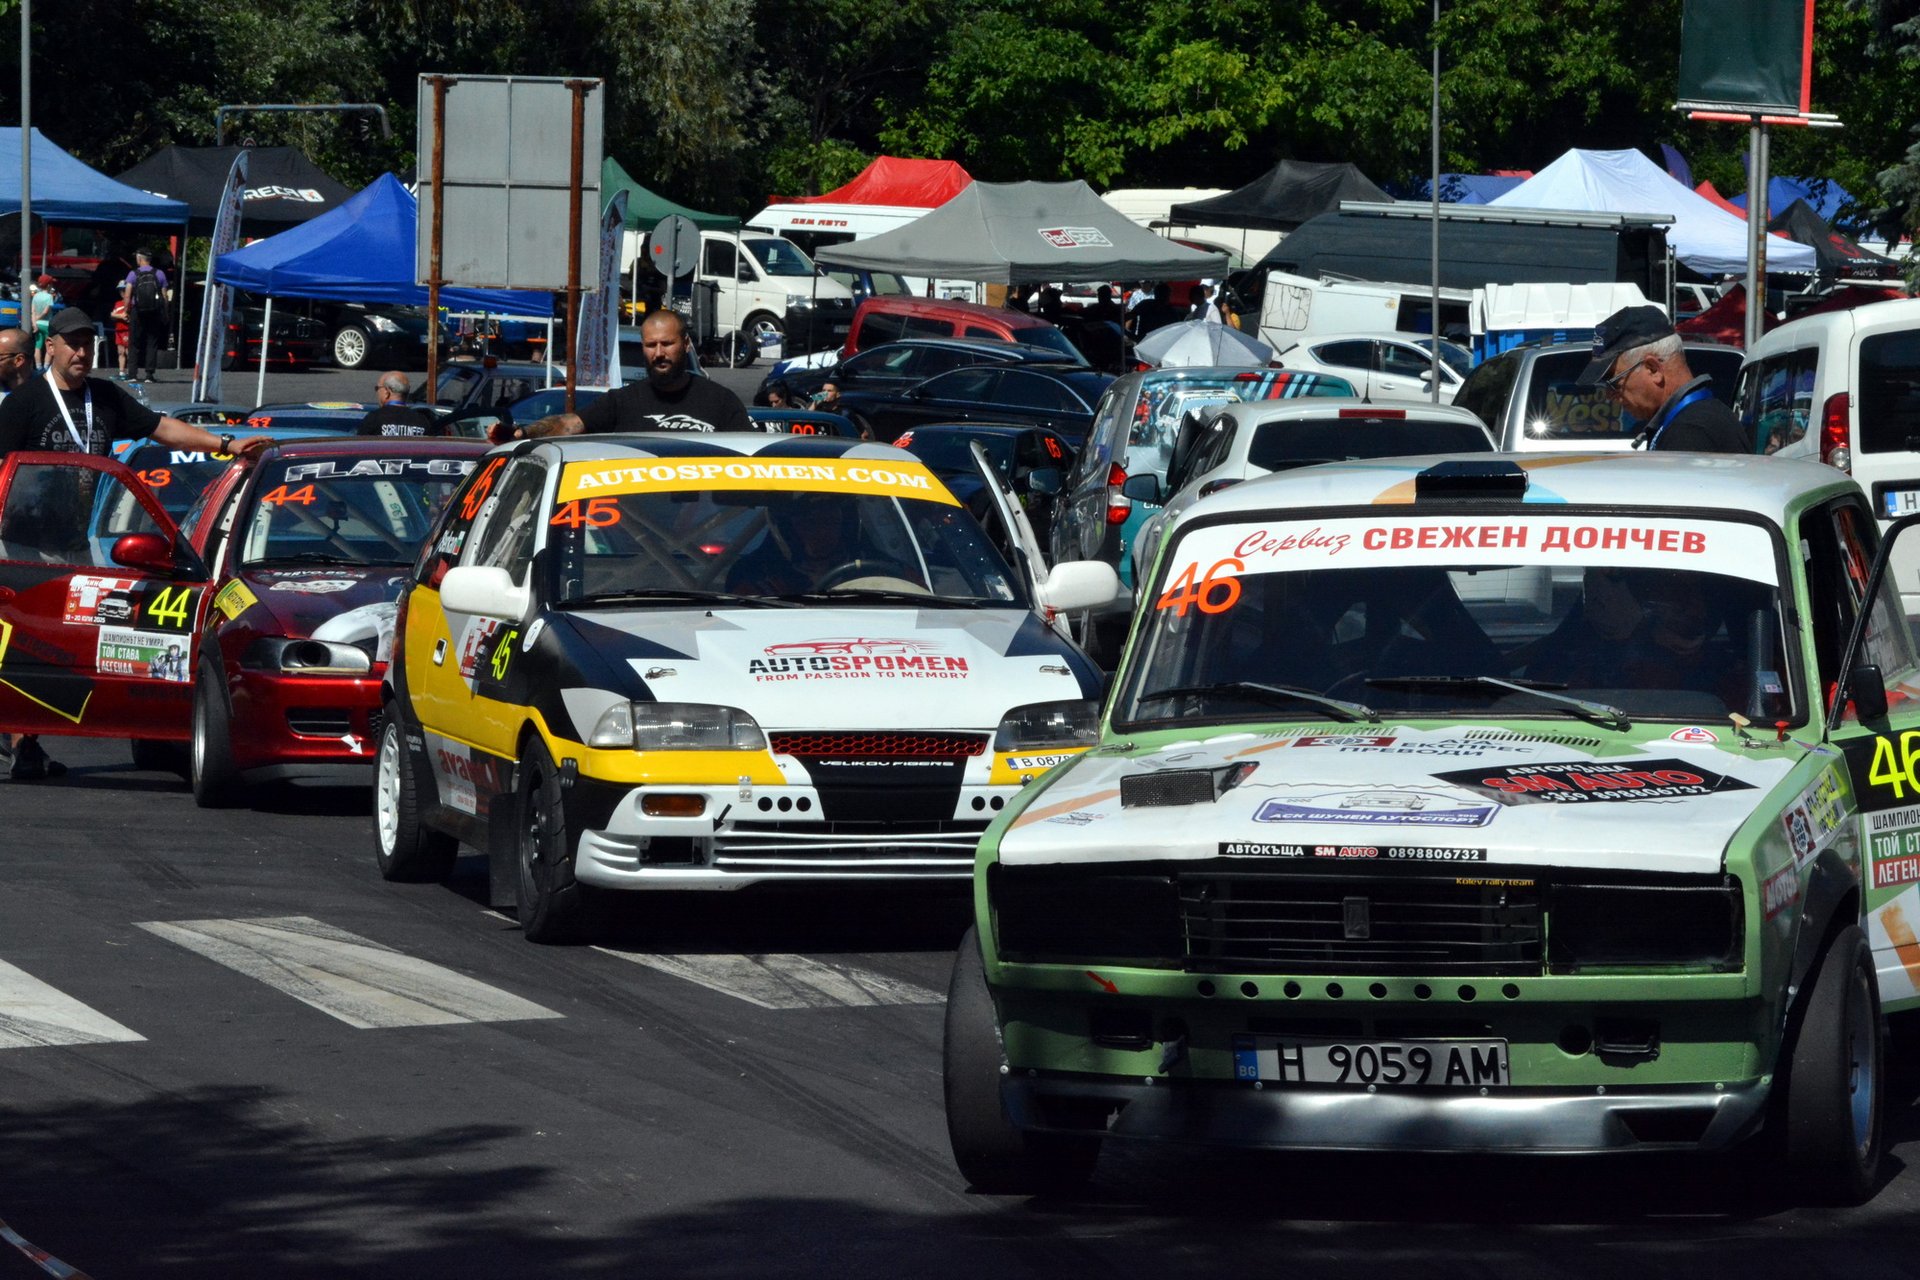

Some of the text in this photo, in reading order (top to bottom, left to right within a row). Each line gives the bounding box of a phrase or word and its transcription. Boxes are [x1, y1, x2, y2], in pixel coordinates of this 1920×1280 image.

[576, 463, 933, 491] AUTOSPOMEN.COM
[261, 484, 317, 505] 44
[460, 456, 507, 520] 45
[550, 498, 621, 528] 45
[1234, 525, 1707, 559] Сервиз СВЕЖЕН ДОНЧЕВ
[1156, 557, 1246, 617] 46
[147, 586, 192, 628] 44
[117, 649, 140, 661] СТАВА
[491, 630, 519, 681] 45
[749, 655, 969, 674] AUTOSPOMEN
[756, 671, 968, 682] FROM PASSION TO MEMORY
[1339, 747, 1483, 757] ПРЕВОДИ
[1401, 742, 1533, 754] ЕКСПРЕС
[1022, 758, 1033, 767] B
[1505, 764, 1632, 775] АВТОКЪЩА
[1482, 769, 1705, 793] SM AUTO
[1597, 784, 1713, 801] 898806732
[1307, 812, 1373, 821] ШУМЕН
[1376, 814, 1478, 823] АУТОСПОРТ
[1226, 844, 1479, 860] АВТОКЪЩА SM AUTO 0898806732
[1875, 832, 1900, 858] ТОЙ
[1456, 877, 1482, 886] Kolev
[1485, 878, 1505, 887] rally
[1239, 1042, 1502, 1085] BG H 9059 AM
